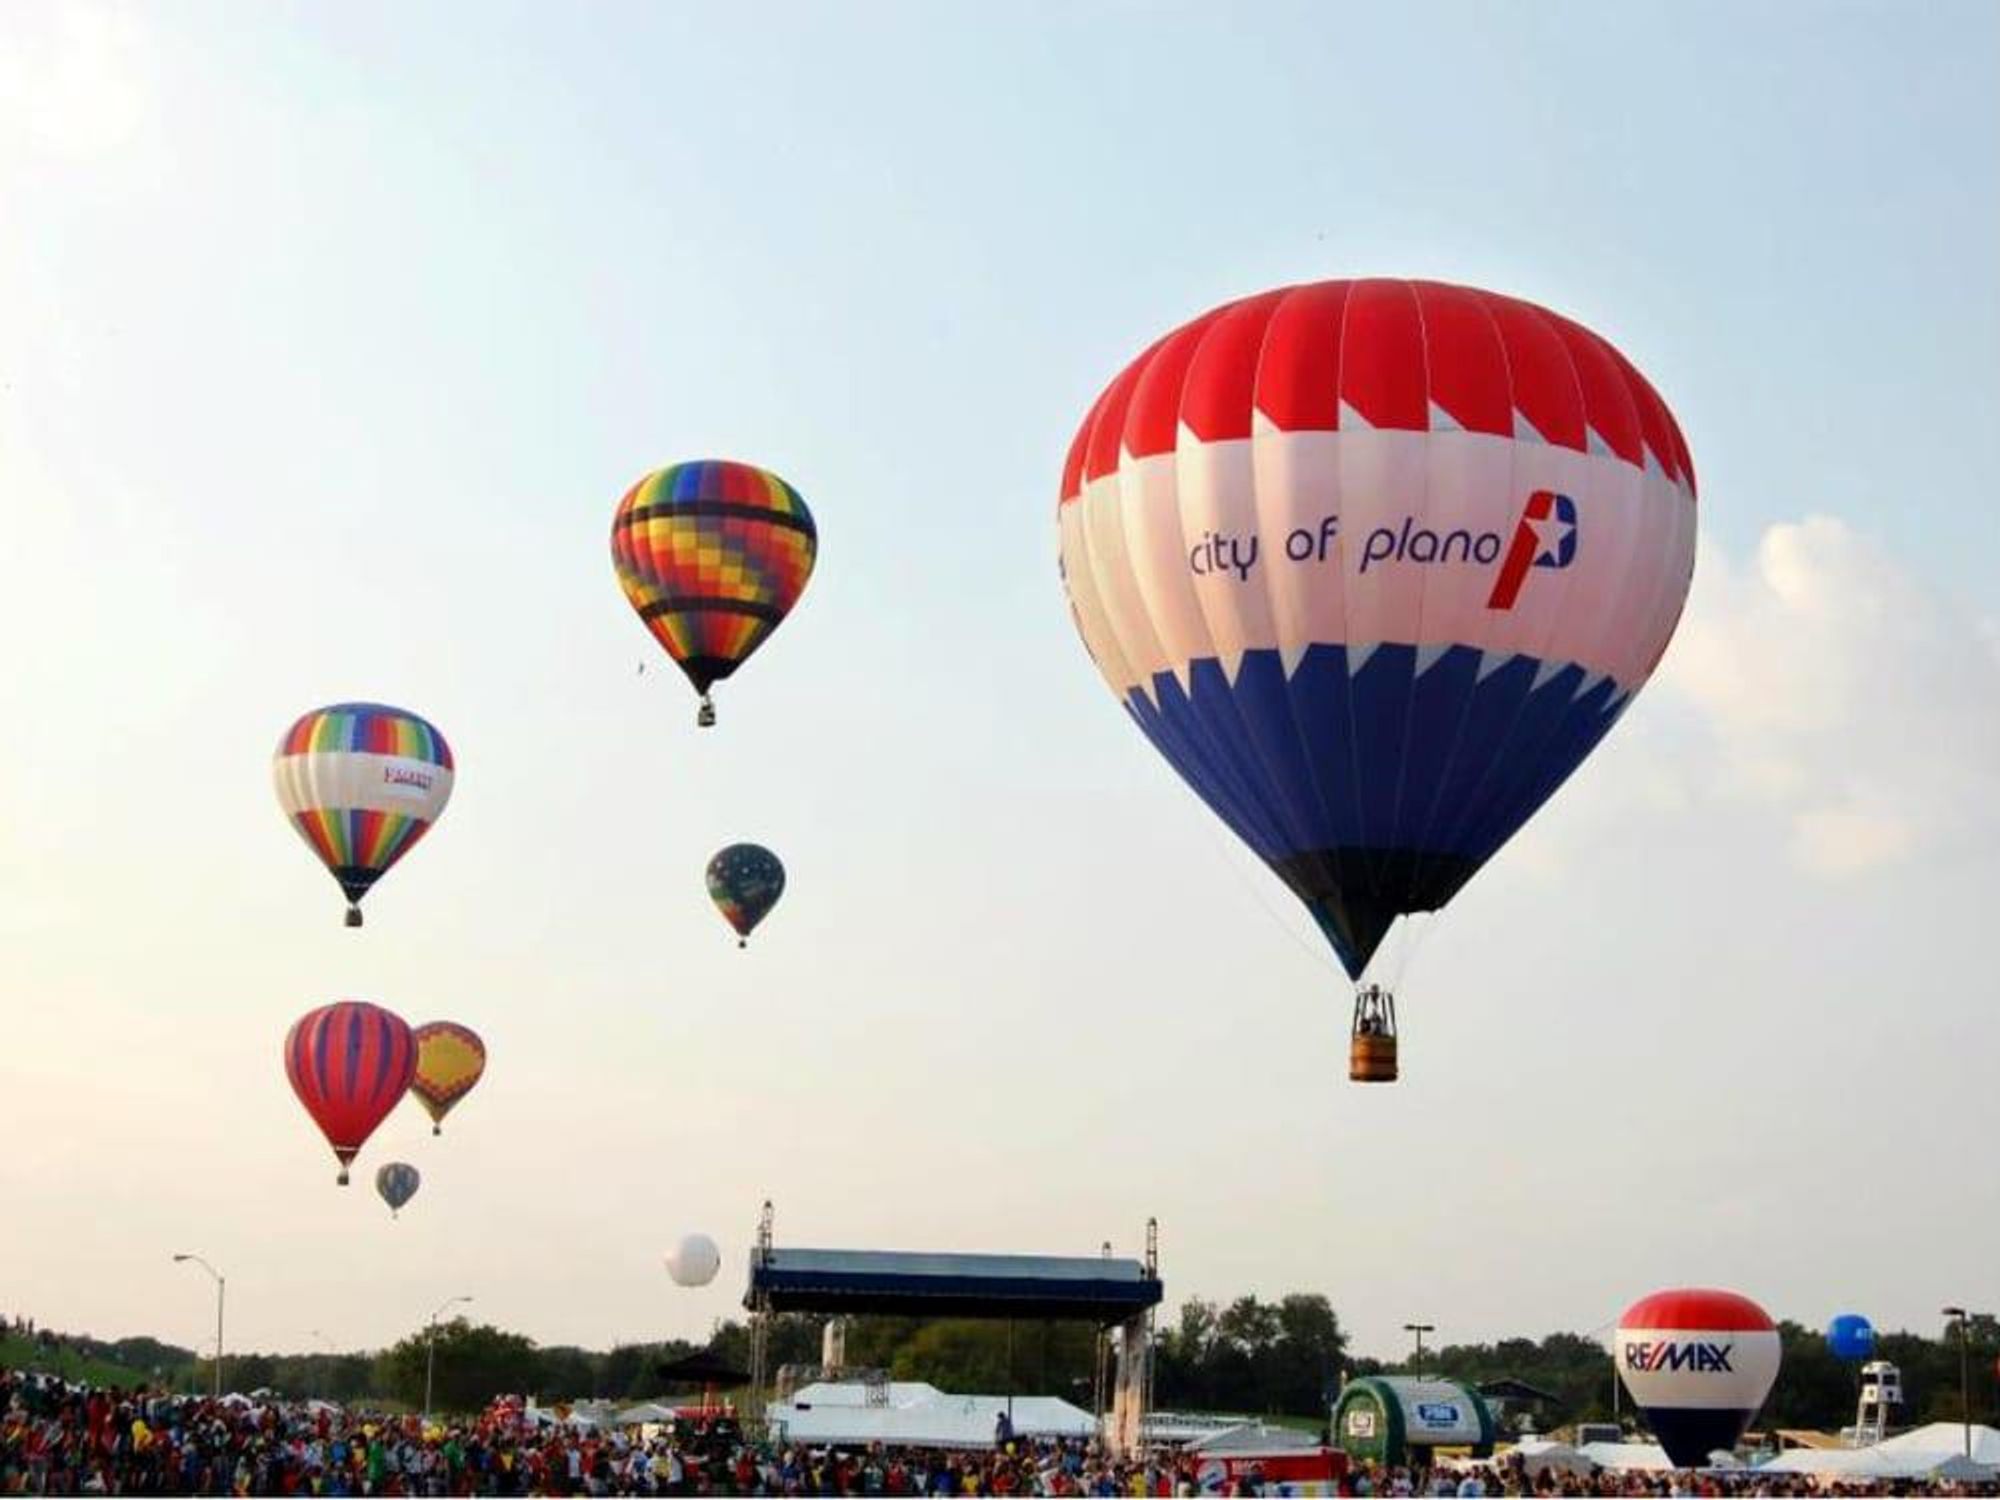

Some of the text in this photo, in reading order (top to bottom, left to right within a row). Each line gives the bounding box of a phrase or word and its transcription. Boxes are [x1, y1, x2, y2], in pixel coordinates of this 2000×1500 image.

[1190, 530, 1258, 582] city
[1286, 515, 1338, 563] of
[1359, 515, 1502, 575] plano
[1625, 1341, 1734, 1373] RE/MAX
